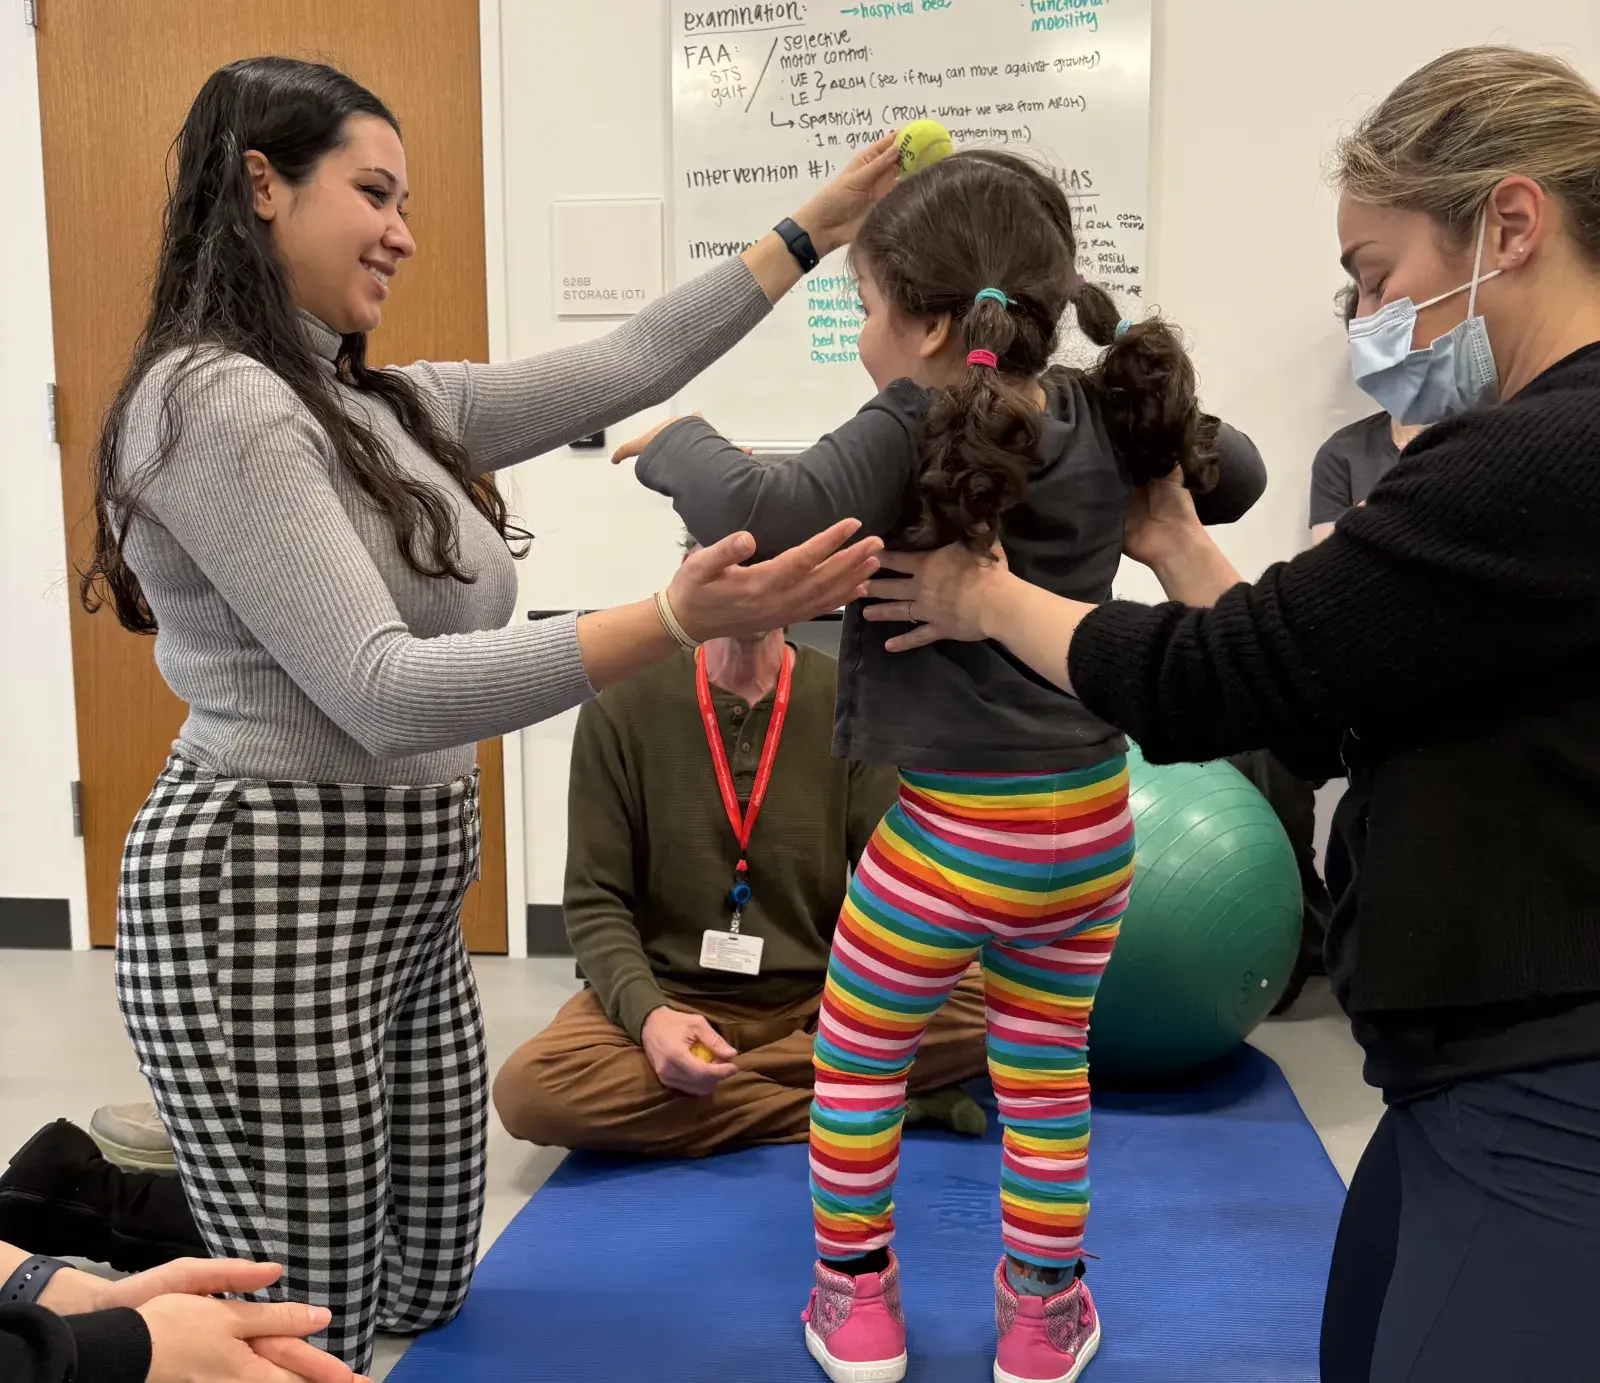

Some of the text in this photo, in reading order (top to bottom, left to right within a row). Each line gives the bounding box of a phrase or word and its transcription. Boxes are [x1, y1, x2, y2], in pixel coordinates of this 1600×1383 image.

[861, 2, 914, 19] hospital
[1030, 0, 1109, 14] functiona
[684, 2, 807, 31] examination:
[1030, 10, 1098, 32] mobility
[783, 29, 851, 51] selective
[780, 53, 817, 70] motor
[709, 65, 743, 84] STS
[903, 69, 915, 85] if
[946, 65, 966, 79] can
[971, 64, 999, 77] move
[1005, 61, 1049, 77] against
[791, 91, 810, 106] LE
[882, 104, 928, 124] (PROM
[976, 105, 991, 116] we
[995, 102, 1015, 113] see
[1017, 100, 1045, 113] from
[1048, 95, 1087, 112] AROM)
[949, 127, 1008, 144] ngthening
[686, 163, 799, 188] intervention
[1070, 204, 1099, 214] rmal
[563, 277, 592, 287] 628B
[563, 289, 646, 300] STORAGE (OT)
